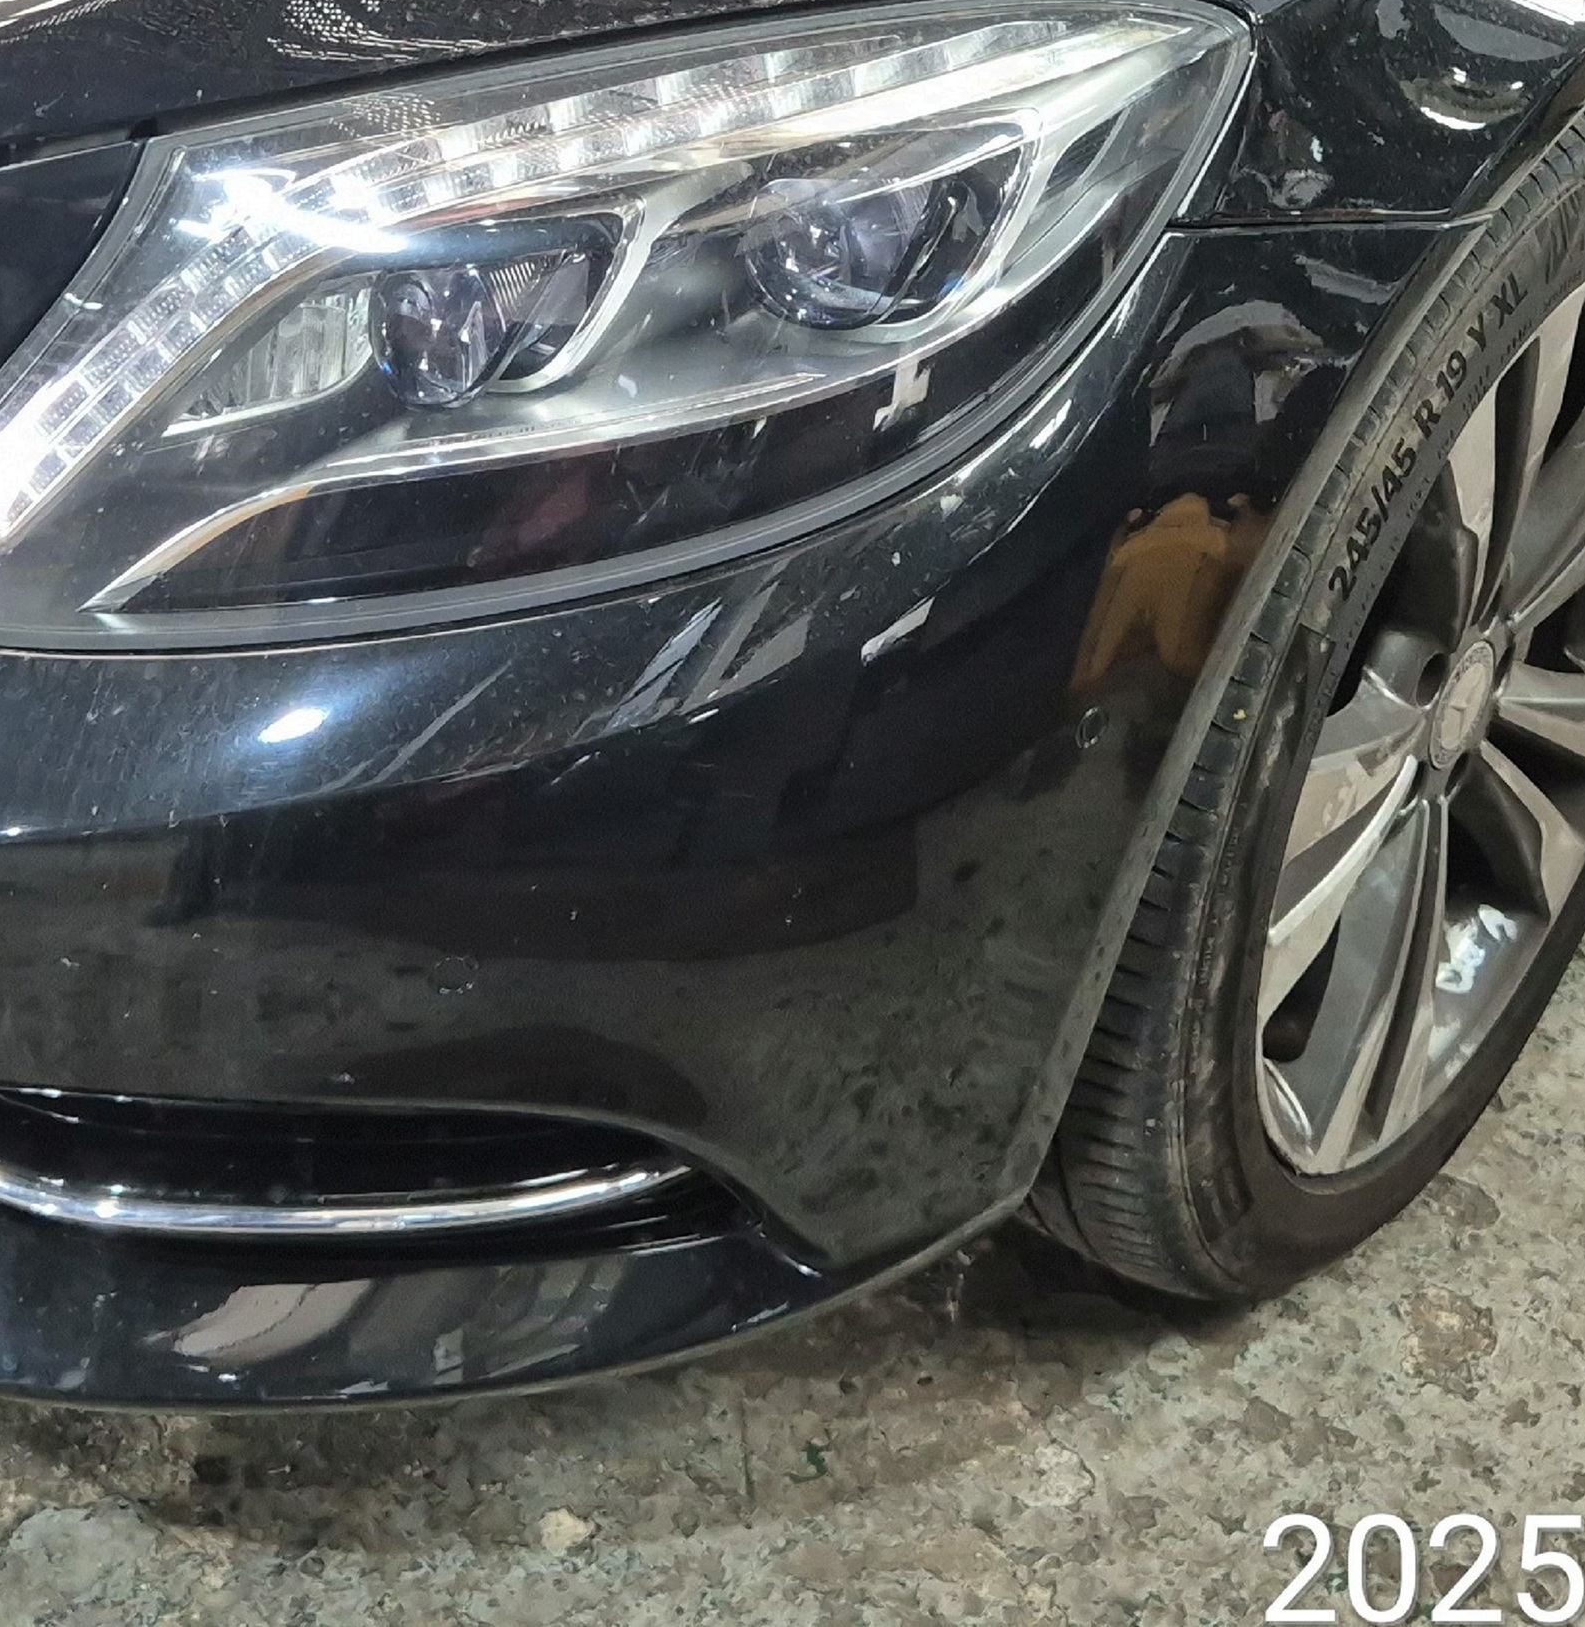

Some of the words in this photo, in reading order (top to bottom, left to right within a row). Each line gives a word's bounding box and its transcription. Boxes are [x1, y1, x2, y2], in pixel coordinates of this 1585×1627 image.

[1327, 436, 1417, 602] 245/45
[1412, 397, 1442, 441] R
[1435, 349, 1467, 402] 19
[1489, 270, 1529, 330] XL
